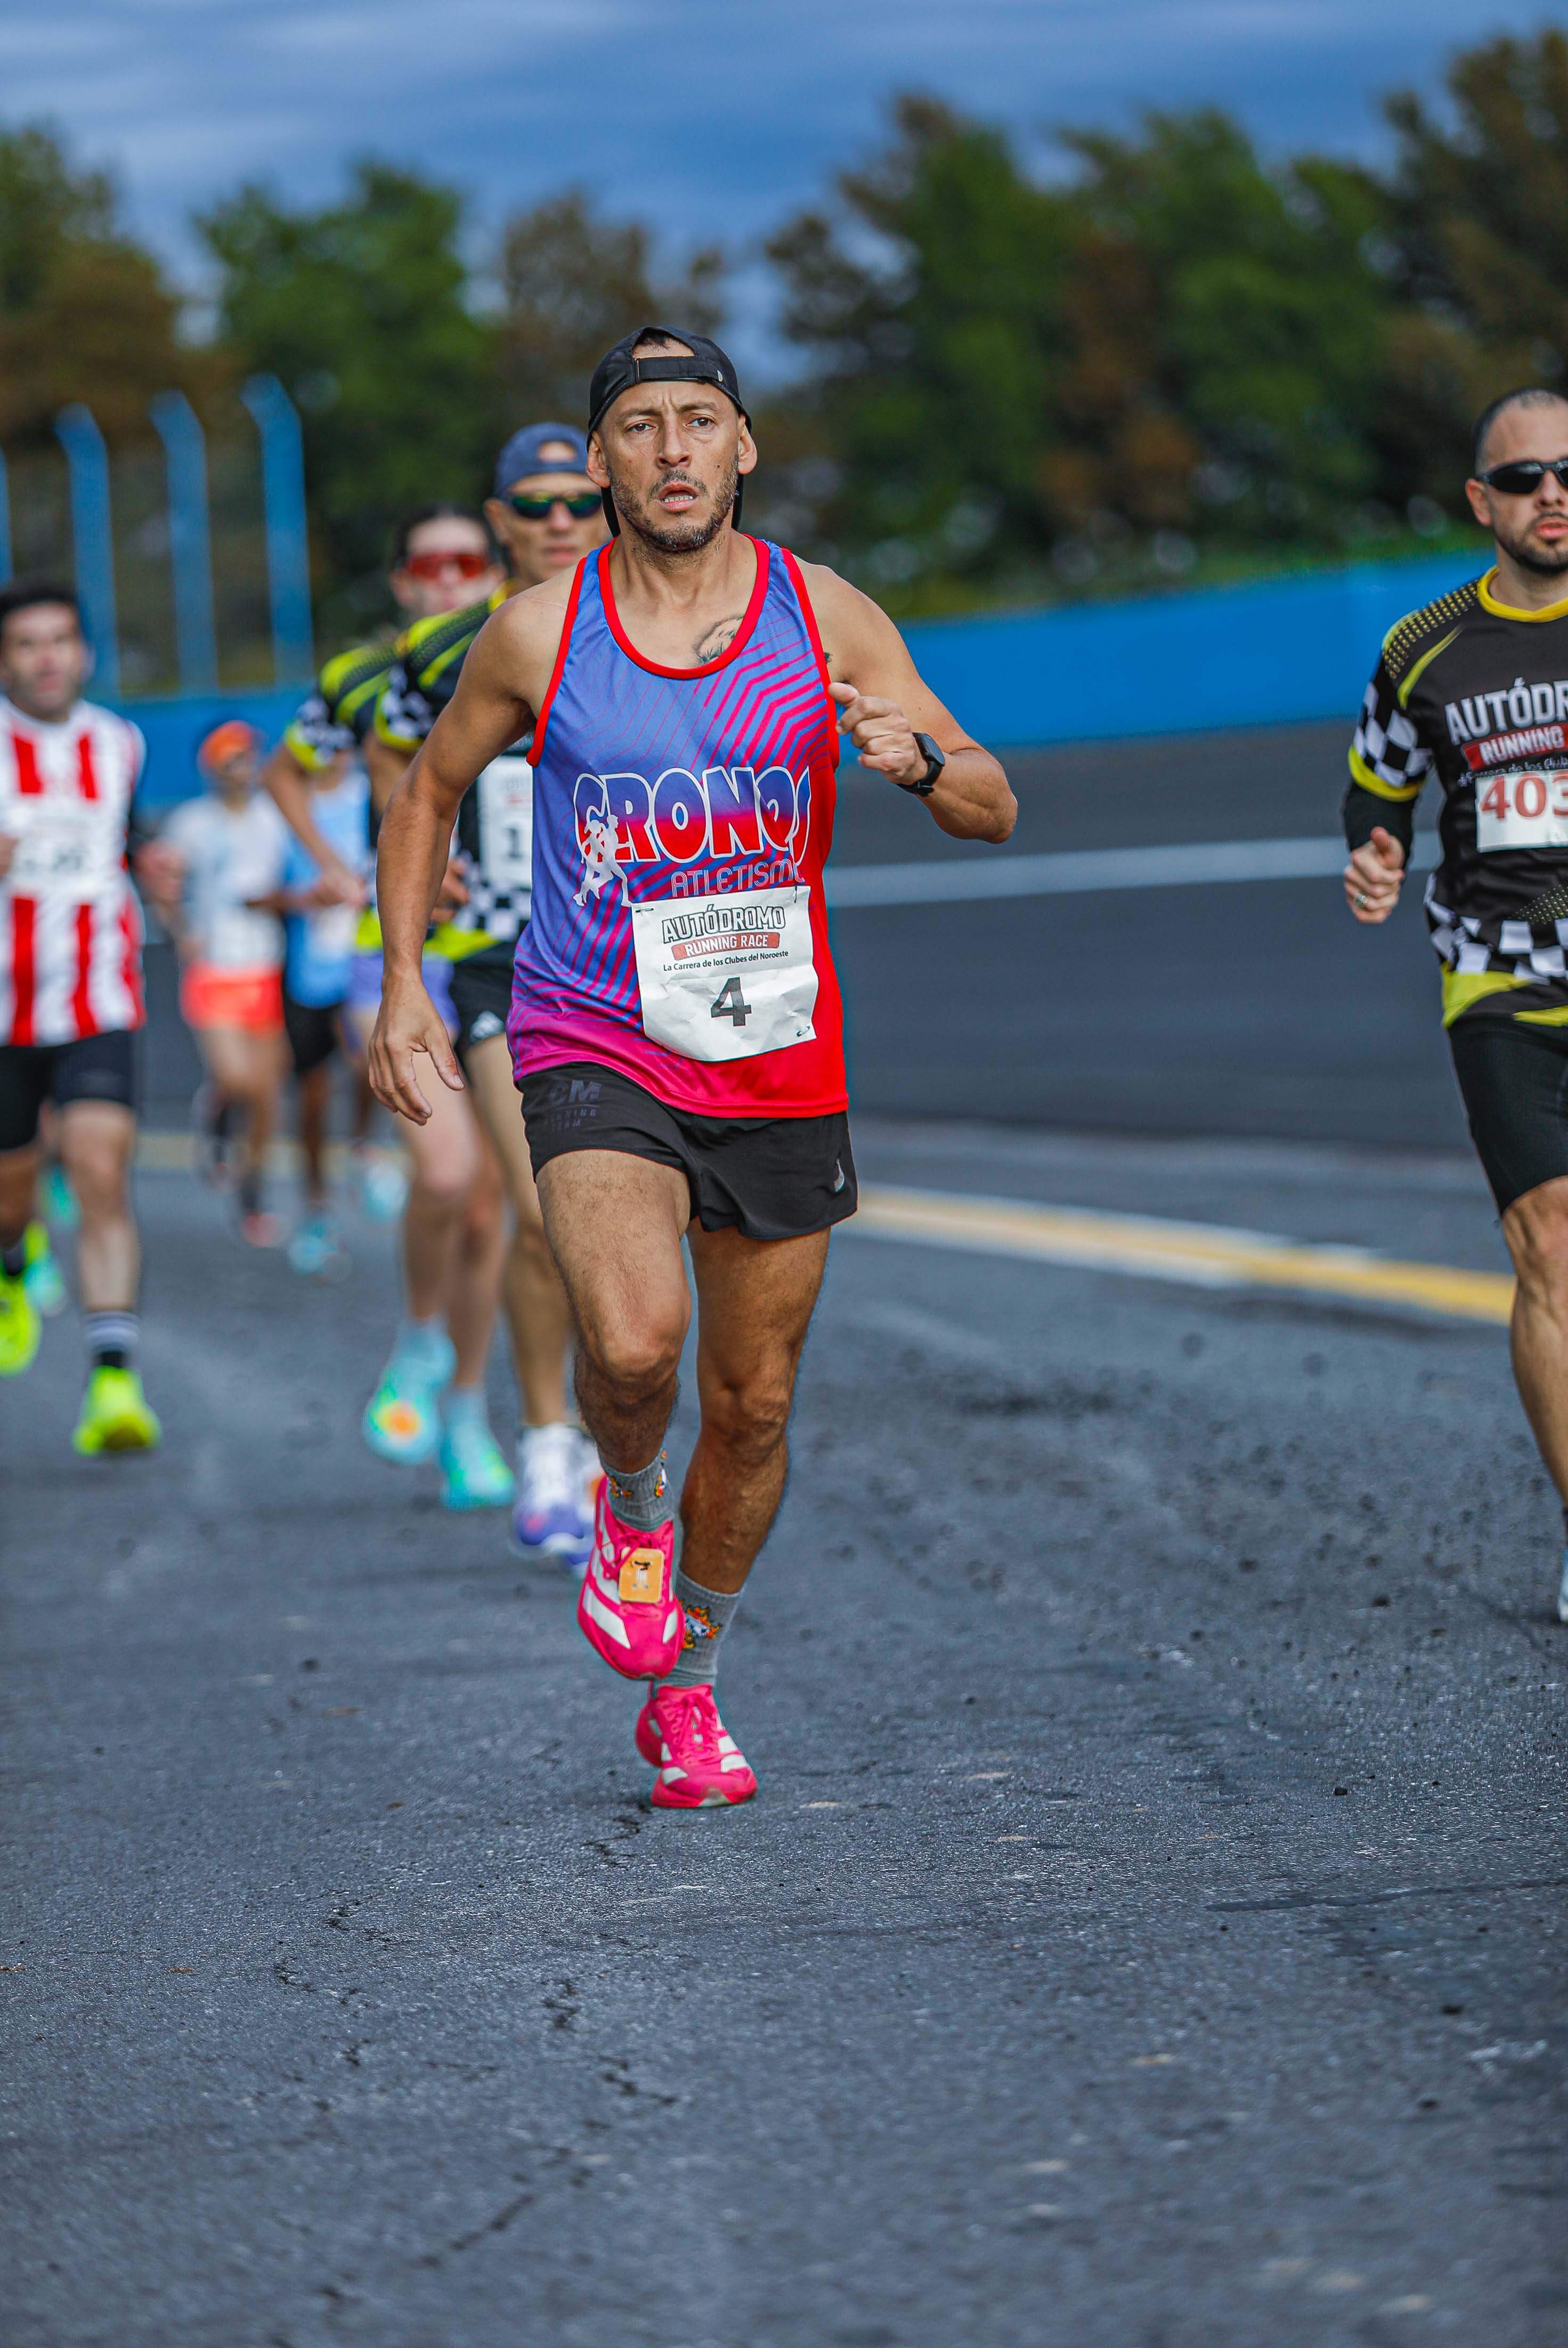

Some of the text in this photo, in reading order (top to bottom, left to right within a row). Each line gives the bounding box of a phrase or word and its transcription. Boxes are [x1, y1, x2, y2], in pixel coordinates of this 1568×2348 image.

[1479, 725, 1565, 765] RUNNING
[662, 904, 786, 944] AUTÓDROMO
[673, 962, 701, 971] Carrera
[725, 956, 747, 964] Clubes
[760, 950, 789, 960] Noroeste
[685, 934, 768, 957] RUNNING RACE
[710, 976, 752, 1027] 4
